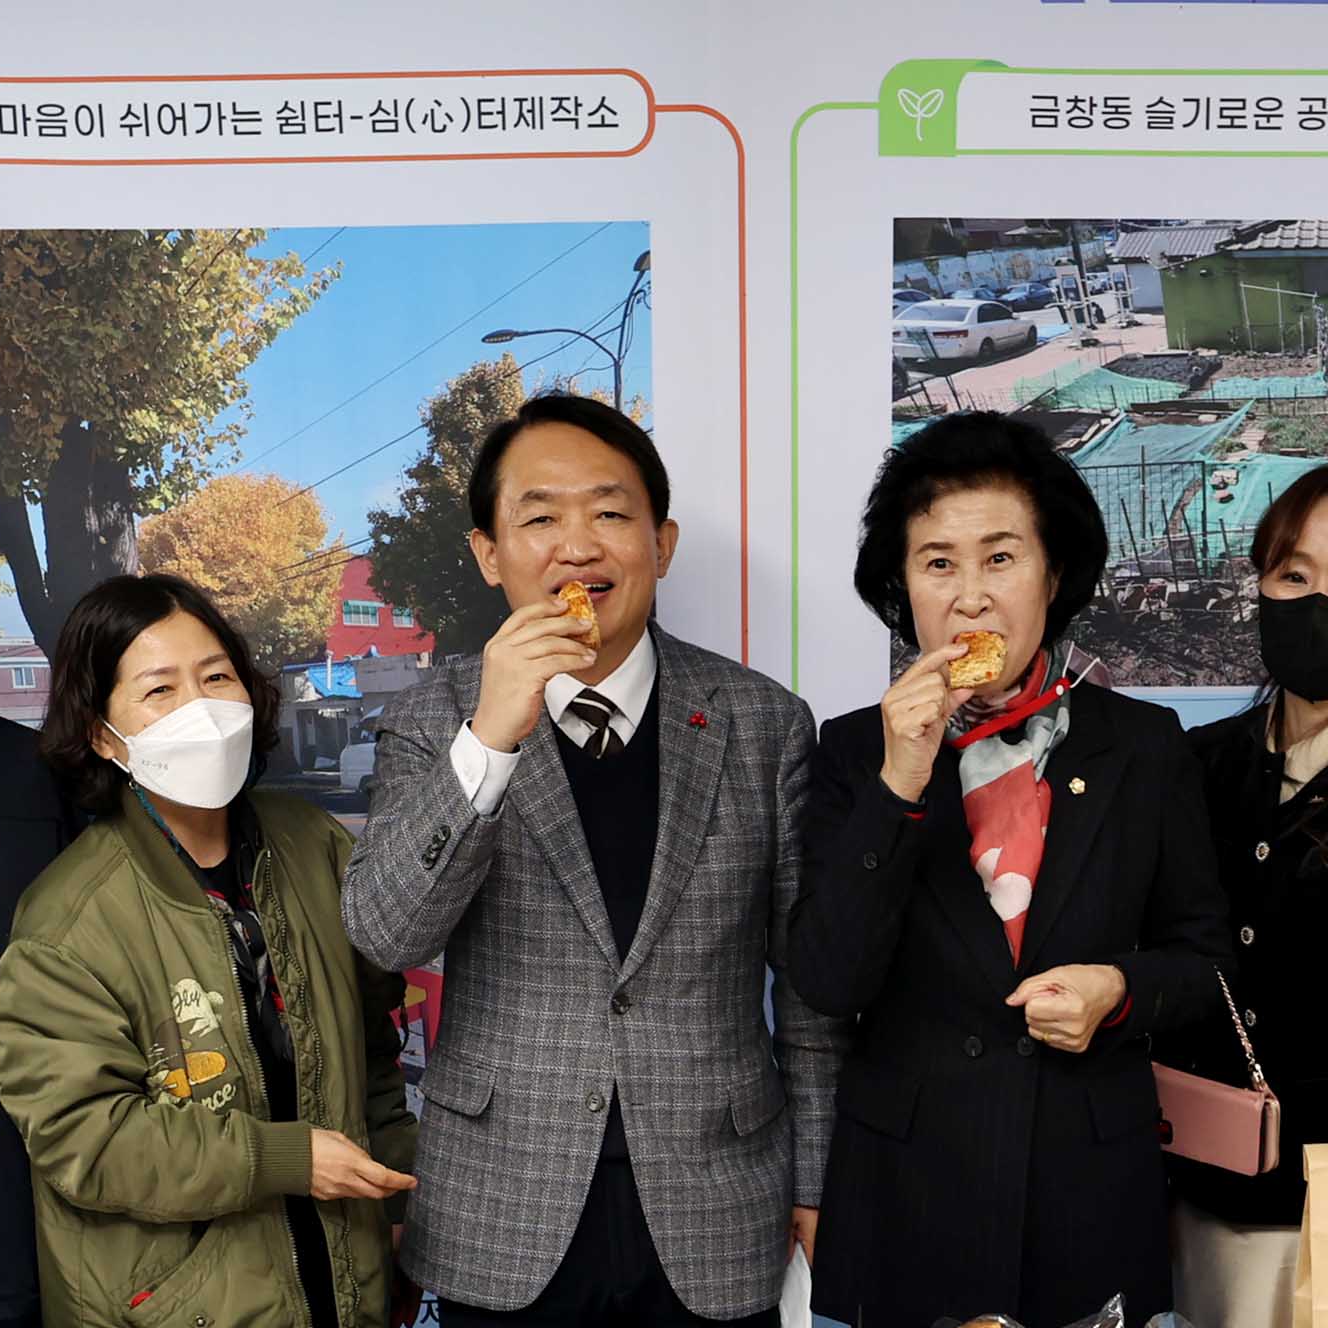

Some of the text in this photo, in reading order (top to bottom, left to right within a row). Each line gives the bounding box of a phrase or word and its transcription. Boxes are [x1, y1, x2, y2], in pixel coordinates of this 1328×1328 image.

[119, 102, 262, 137] 쉬어가는
[276, 95, 619, 135] 쉼터-심(心)터제작소
[1029, 95, 1132, 130] 금창동
[1145, 96, 1284, 131] 슬기로운
